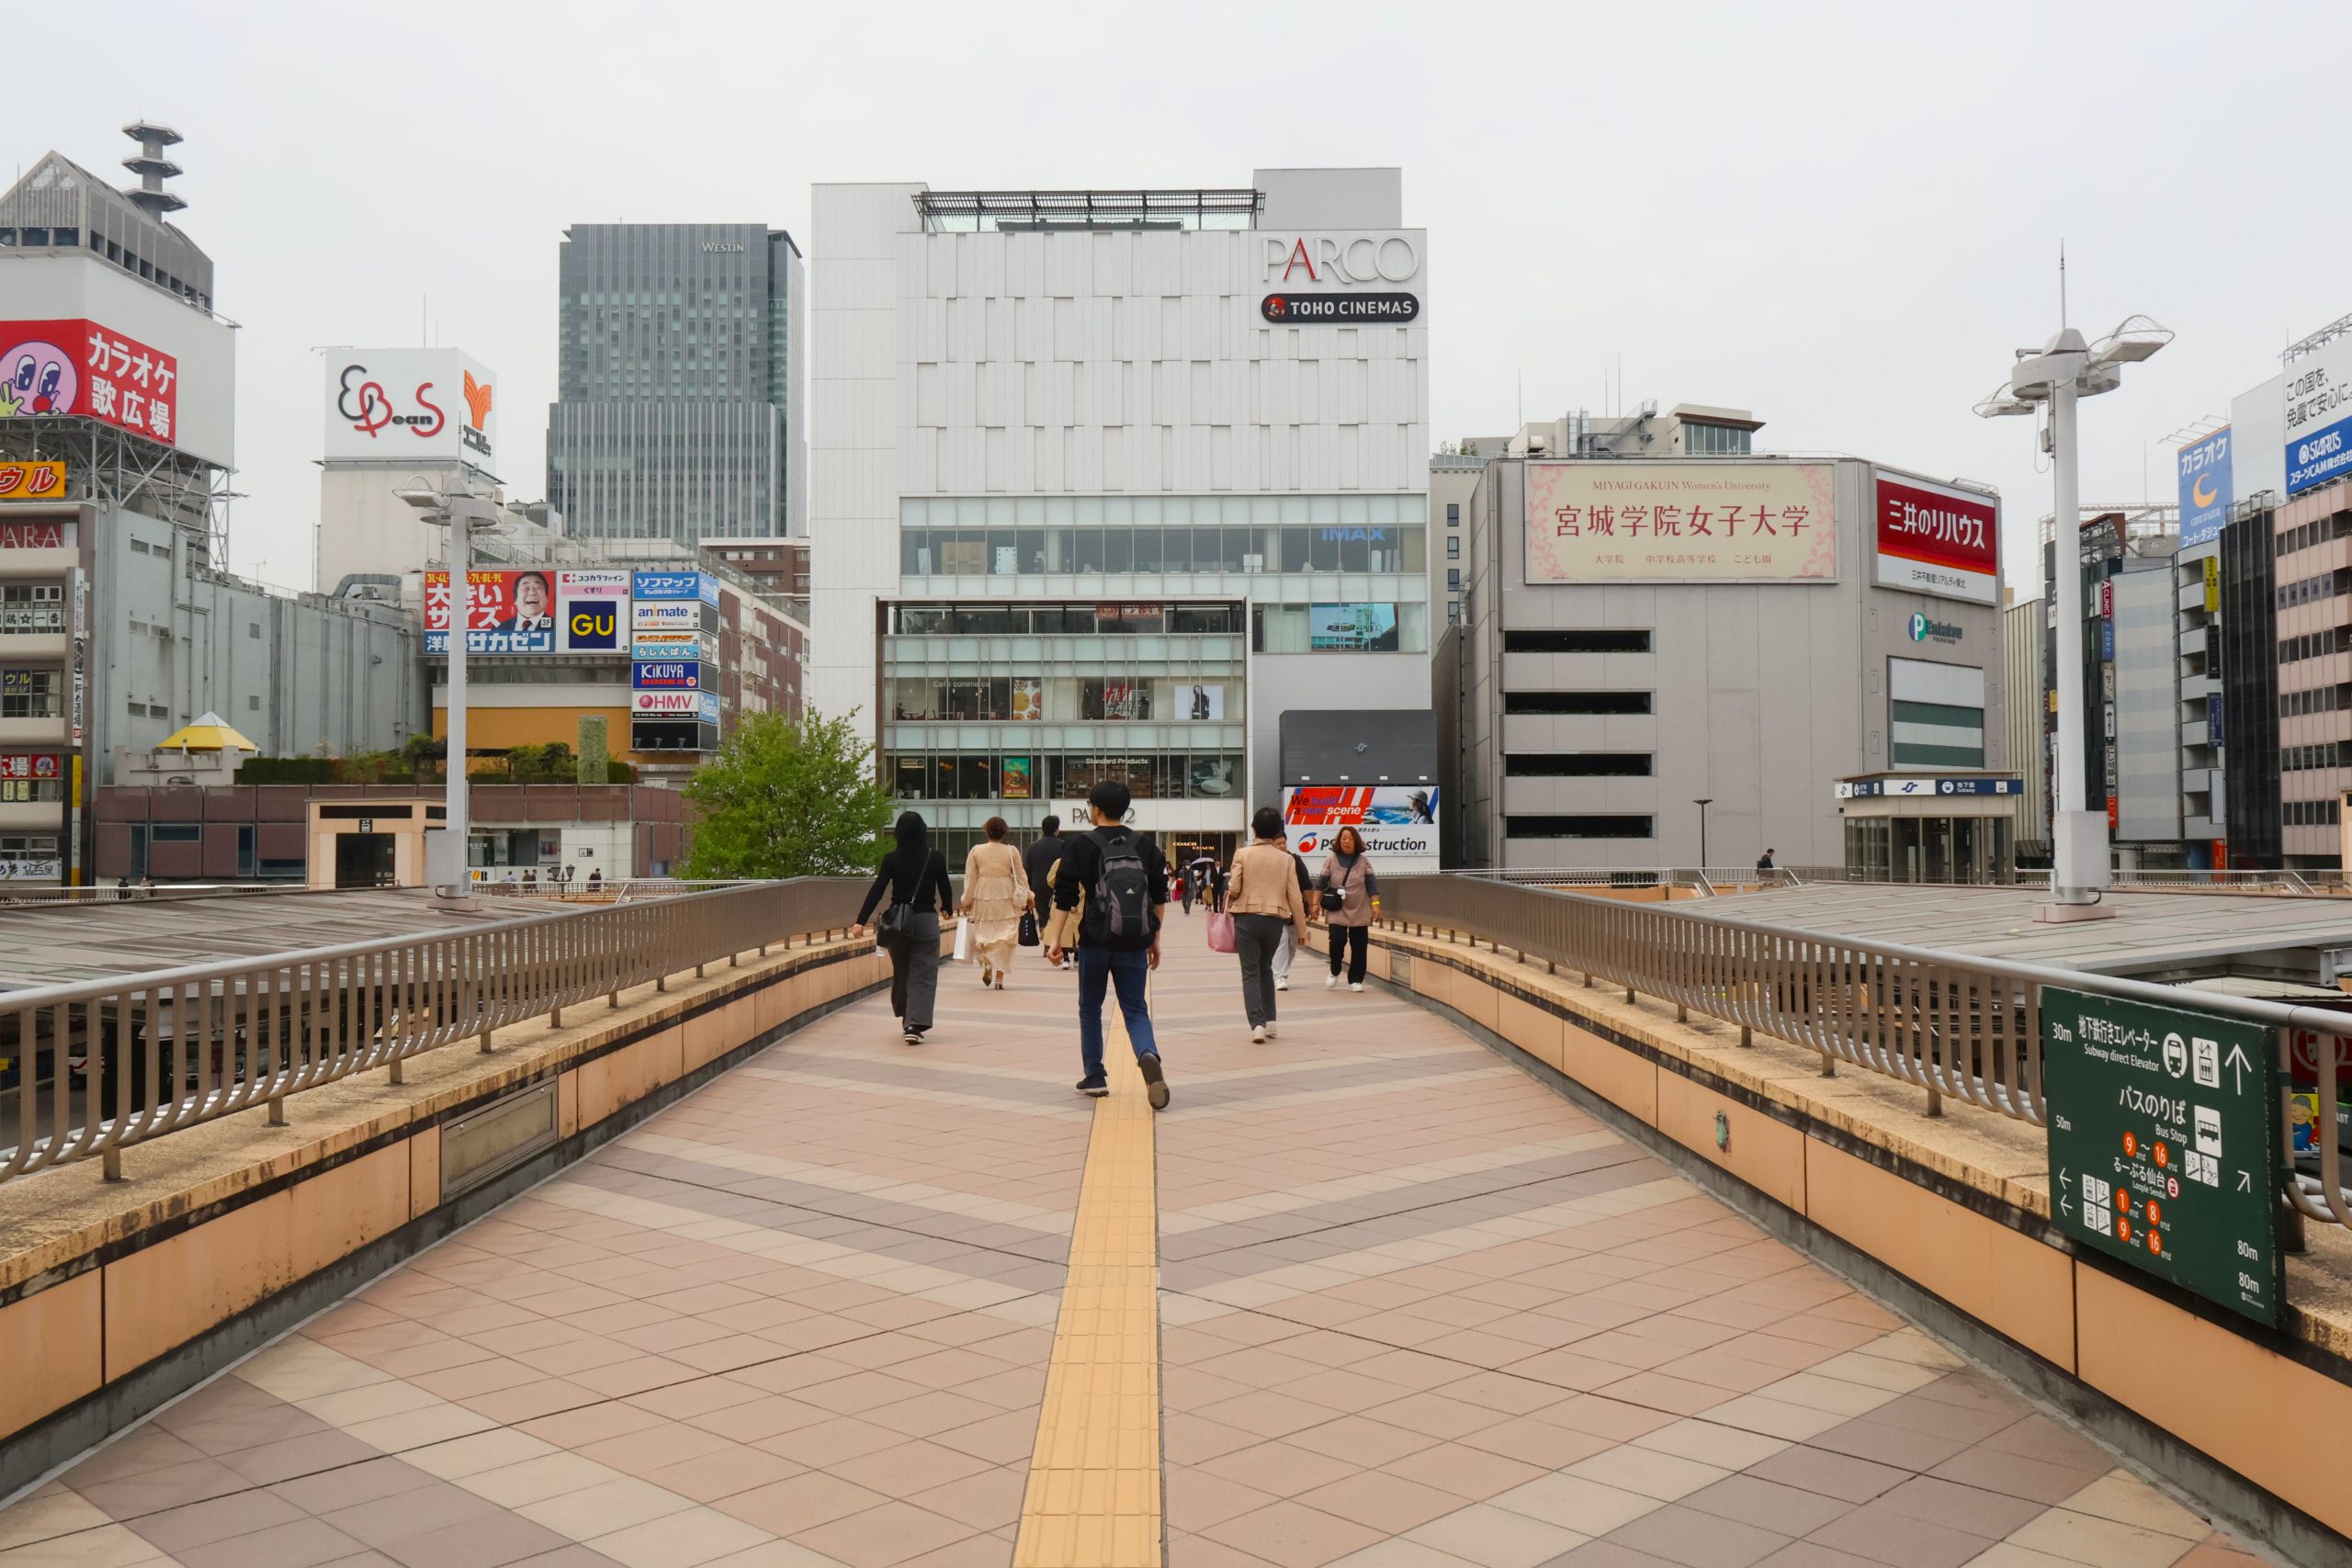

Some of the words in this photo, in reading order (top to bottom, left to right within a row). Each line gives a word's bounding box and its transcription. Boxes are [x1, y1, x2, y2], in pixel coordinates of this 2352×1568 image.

[1261, 237, 1419, 284] PARCO
[1290, 301, 1334, 315] TOHO
[1339, 300, 1412, 314] CINEMAS
[88, 332, 175, 395] カラオケ
[2287, 367, 2329, 401] この国を、
[91, 376, 170, 438] 歌広場
[2181, 435, 2227, 477] カラオケ
[2309, 431, 2342, 461] STARTS
[1592, 480, 1632, 491] MIYAGI
[1634, 480, 1679, 491] GAKUIN
[1682, 480, 1723, 491] Women's
[1724, 480, 1771, 492] University
[1555, 504, 1810, 537] 宮城学院女子大学
[1889, 499, 1985, 549] 三井のリハウス
[1322, 527, 1385, 541] IMAX
[1594, 554, 1625, 564] 大学院
[1645, 554, 1716, 564] 中学校高等学校
[637, 577, 696, 588] ソフマップ
[541, 618, 551, 626] 3F
[638, 604, 688, 617] animate
[571, 614, 615, 637] GU
[639, 648, 691, 657] らしんばん
[654, 694, 693, 709] HMV
[1291, 795, 1309, 806] We
[1310, 795, 1339, 806] build
[1327, 806, 1362, 815] scene
[2052, 1022, 2073, 1043] 30m
[2078, 1013, 2158, 1053] 地下鉄行きエレベーター
[2084, 1043, 2109, 1062] Subway
[2110, 1049, 2131, 1066] direct
[2131, 1055, 2160, 1072] Elevator
[2119, 1085, 2187, 1125] バスのりば
[2055, 1114, 2072, 1132] 50m
[2155, 1123, 2169, 1138] Bus
[2170, 1128, 2188, 1146] Stop
[2113, 1156, 2165, 1190] るーぷる仙台
[2237, 1240, 2258, 1261] 80m
[2238, 1271, 2259, 1294] 80m
